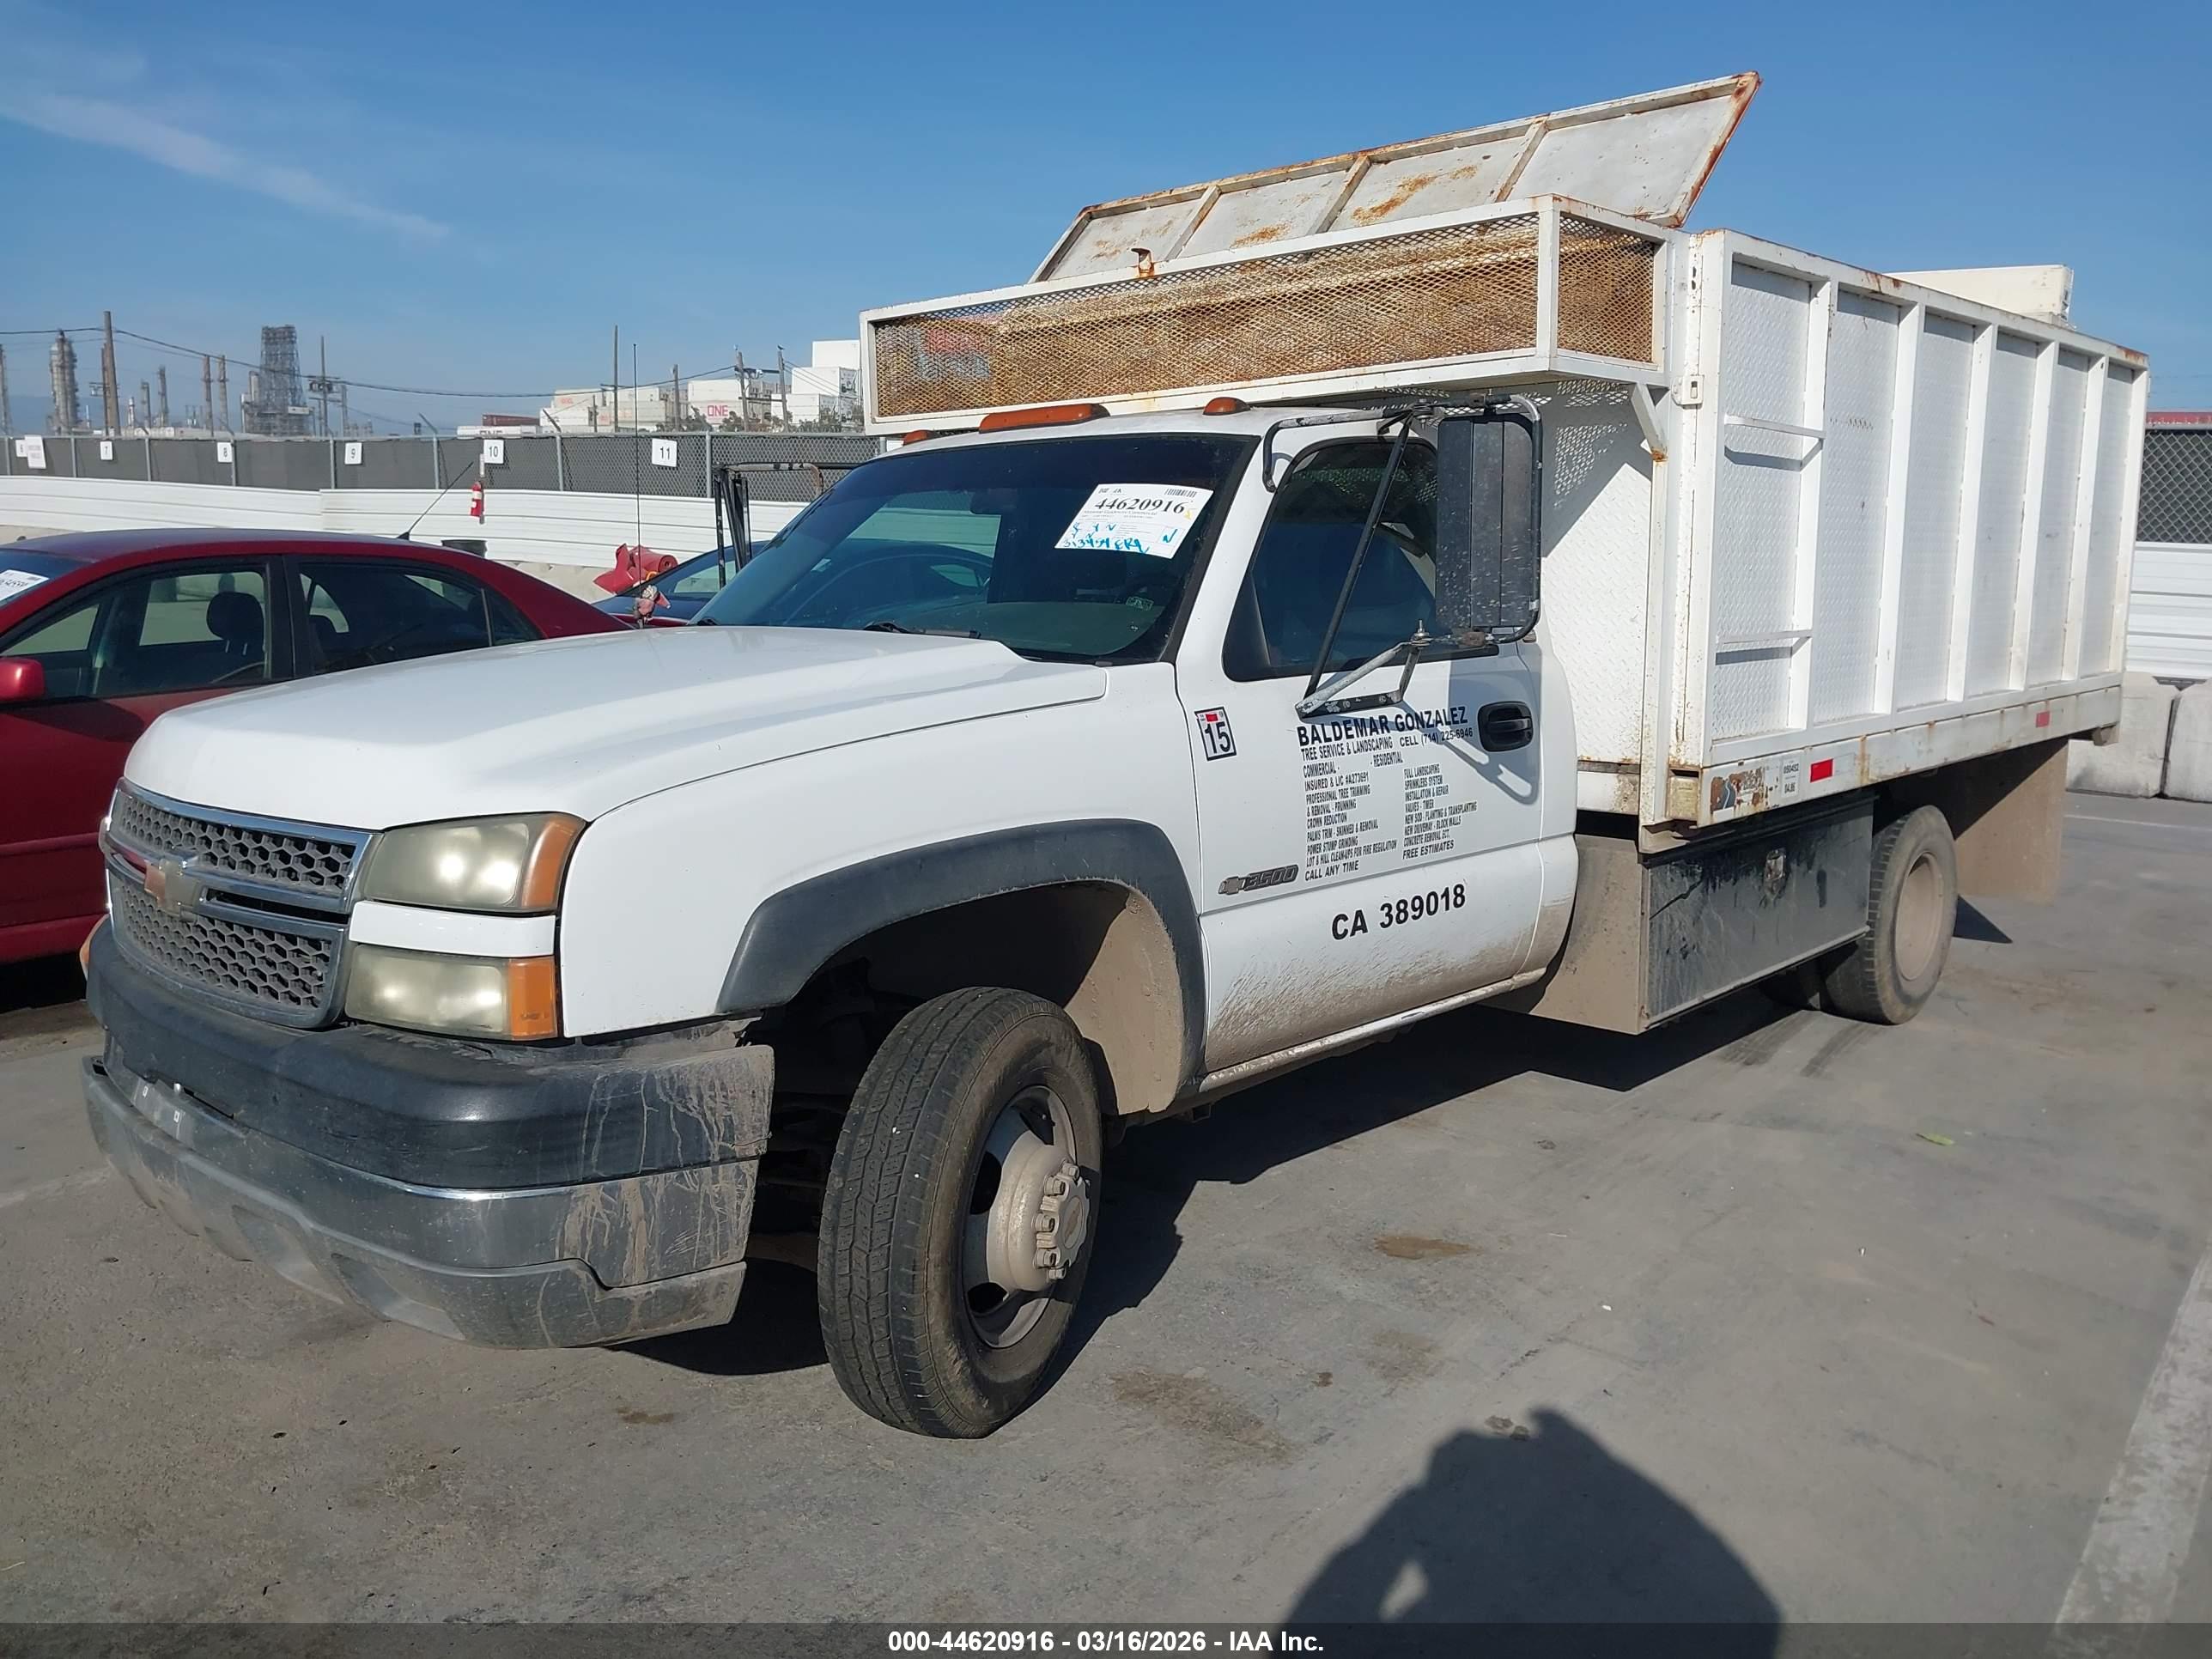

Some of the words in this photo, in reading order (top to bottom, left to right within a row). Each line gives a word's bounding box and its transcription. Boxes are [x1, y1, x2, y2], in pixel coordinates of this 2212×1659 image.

[708, 404, 728, 417] ONE
[222, 447, 228, 458] 8
[351, 448, 356, 459] 9
[489, 447, 498, 457] 10
[659, 447, 670, 460] 11
[1095, 498, 1188, 514] 44620916
[1297, 714, 1390, 746] BALDEMAR
[1395, 706, 1468, 732] GONZALEZ
[1205, 721, 1231, 754] 15
[1400, 736, 1419, 747] CELL
[1421, 732, 1438, 746] (714)
[1441, 727, 1473, 742] 225-6946
[1301, 747, 1317, 762] TREE
[1319, 742, 1345, 759] SERVICE
[1347, 743, 1352, 755] &
[1352, 736, 1393, 753] LANDSCAPING
[1373, 751, 1403, 767] RESIDENTIAL
[1304, 761, 1336, 778] COMMERCIAL
[1404, 769, 1413, 779] FULL
[1414, 763, 1440, 777] LANDSCAPING
[1305, 778, 1328, 791] INSURED
[1330, 777, 1334, 787] &
[1405, 777, 1427, 790] SPRINKLERS
[1429, 775, 1443, 787] SYSTEM
[1306, 790, 1337, 805] PROFESSIONAL
[1338, 787, 1349, 799] TREE
[1350, 784, 1370, 797] TRIMMING
[1405, 787, 1431, 801] INSTALLATION
[1436, 785, 1449, 797] REPAIR
[1311, 803, 1331, 816] REMOVAL
[1405, 814, 1413, 824] NEW
[1425, 808, 1443, 821] PLANTING
[1448, 801, 1477, 816] TRANSPLANTING
[1307, 817, 1322, 829] CROWN
[1324, 812, 1347, 825] REDUCTION
[1405, 825, 1413, 836] NEW
[1436, 818, 1448, 830] BLOCK
[1449, 815, 1461, 827] WALLS
[1307, 830, 1321, 842] PALMS
[1322, 828, 1333, 839] TRIM
[1336, 823, 1354, 836] SKINNED
[1359, 818, 1378, 832] REMOVAL
[1404, 835, 1424, 847] CONCRETE
[1424, 830, 1441, 842] REMOVAL
[1306, 856, 1315, 867] LOT
[1363, 844, 1372, 855] FIRE
[1373, 840, 1397, 854] REGULATION
[1307, 843, 1322, 855] POWER
[1323, 841, 1337, 853] STUMP
[1339, 836, 1358, 849] GRINDING
[1402, 848, 1419, 860] FREE
[1420, 840, 1454, 856] ESTIMATES
[1244, 866, 1297, 890] 3500
[1305, 868, 1322, 881] CALL
[1324, 864, 1340, 877] ANY
[1342, 860, 1359, 873] TIME
[1332, 909, 1369, 940] CA
[1380, 884, 1466, 929] 389018
